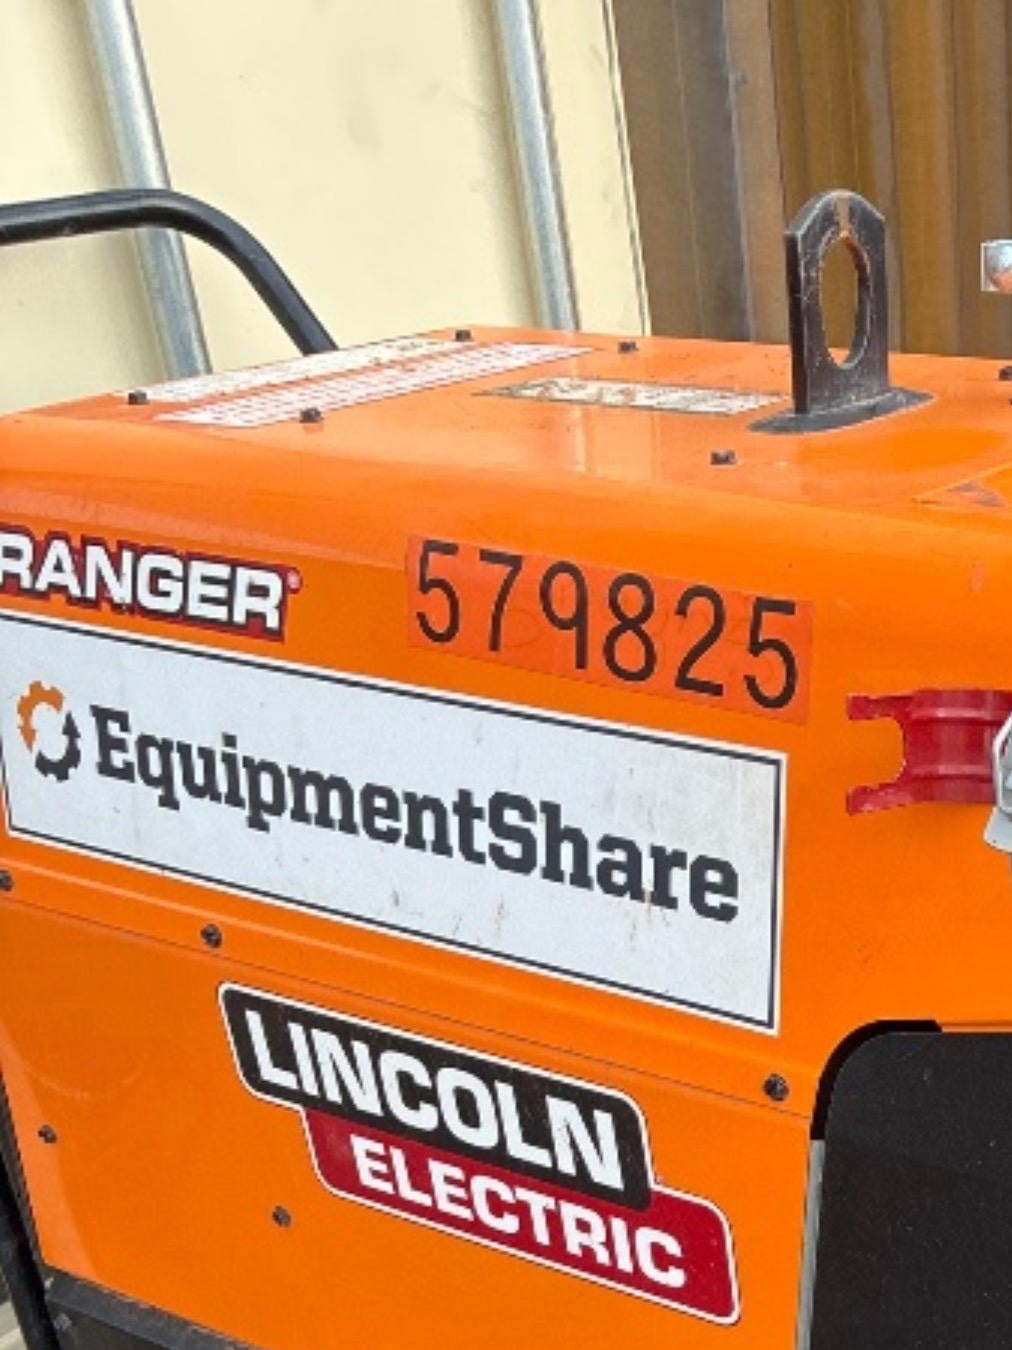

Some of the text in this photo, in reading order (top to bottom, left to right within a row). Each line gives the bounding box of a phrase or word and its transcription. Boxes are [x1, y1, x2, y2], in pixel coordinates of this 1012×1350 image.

[0, 532, 283, 630] RANGER
[416, 540, 798, 709] 579825
[89, 705, 739, 922] EquipmentShare
[245, 1009, 625, 1190] LINCOLN
[350, 1134, 686, 1288] ELECTRIC
